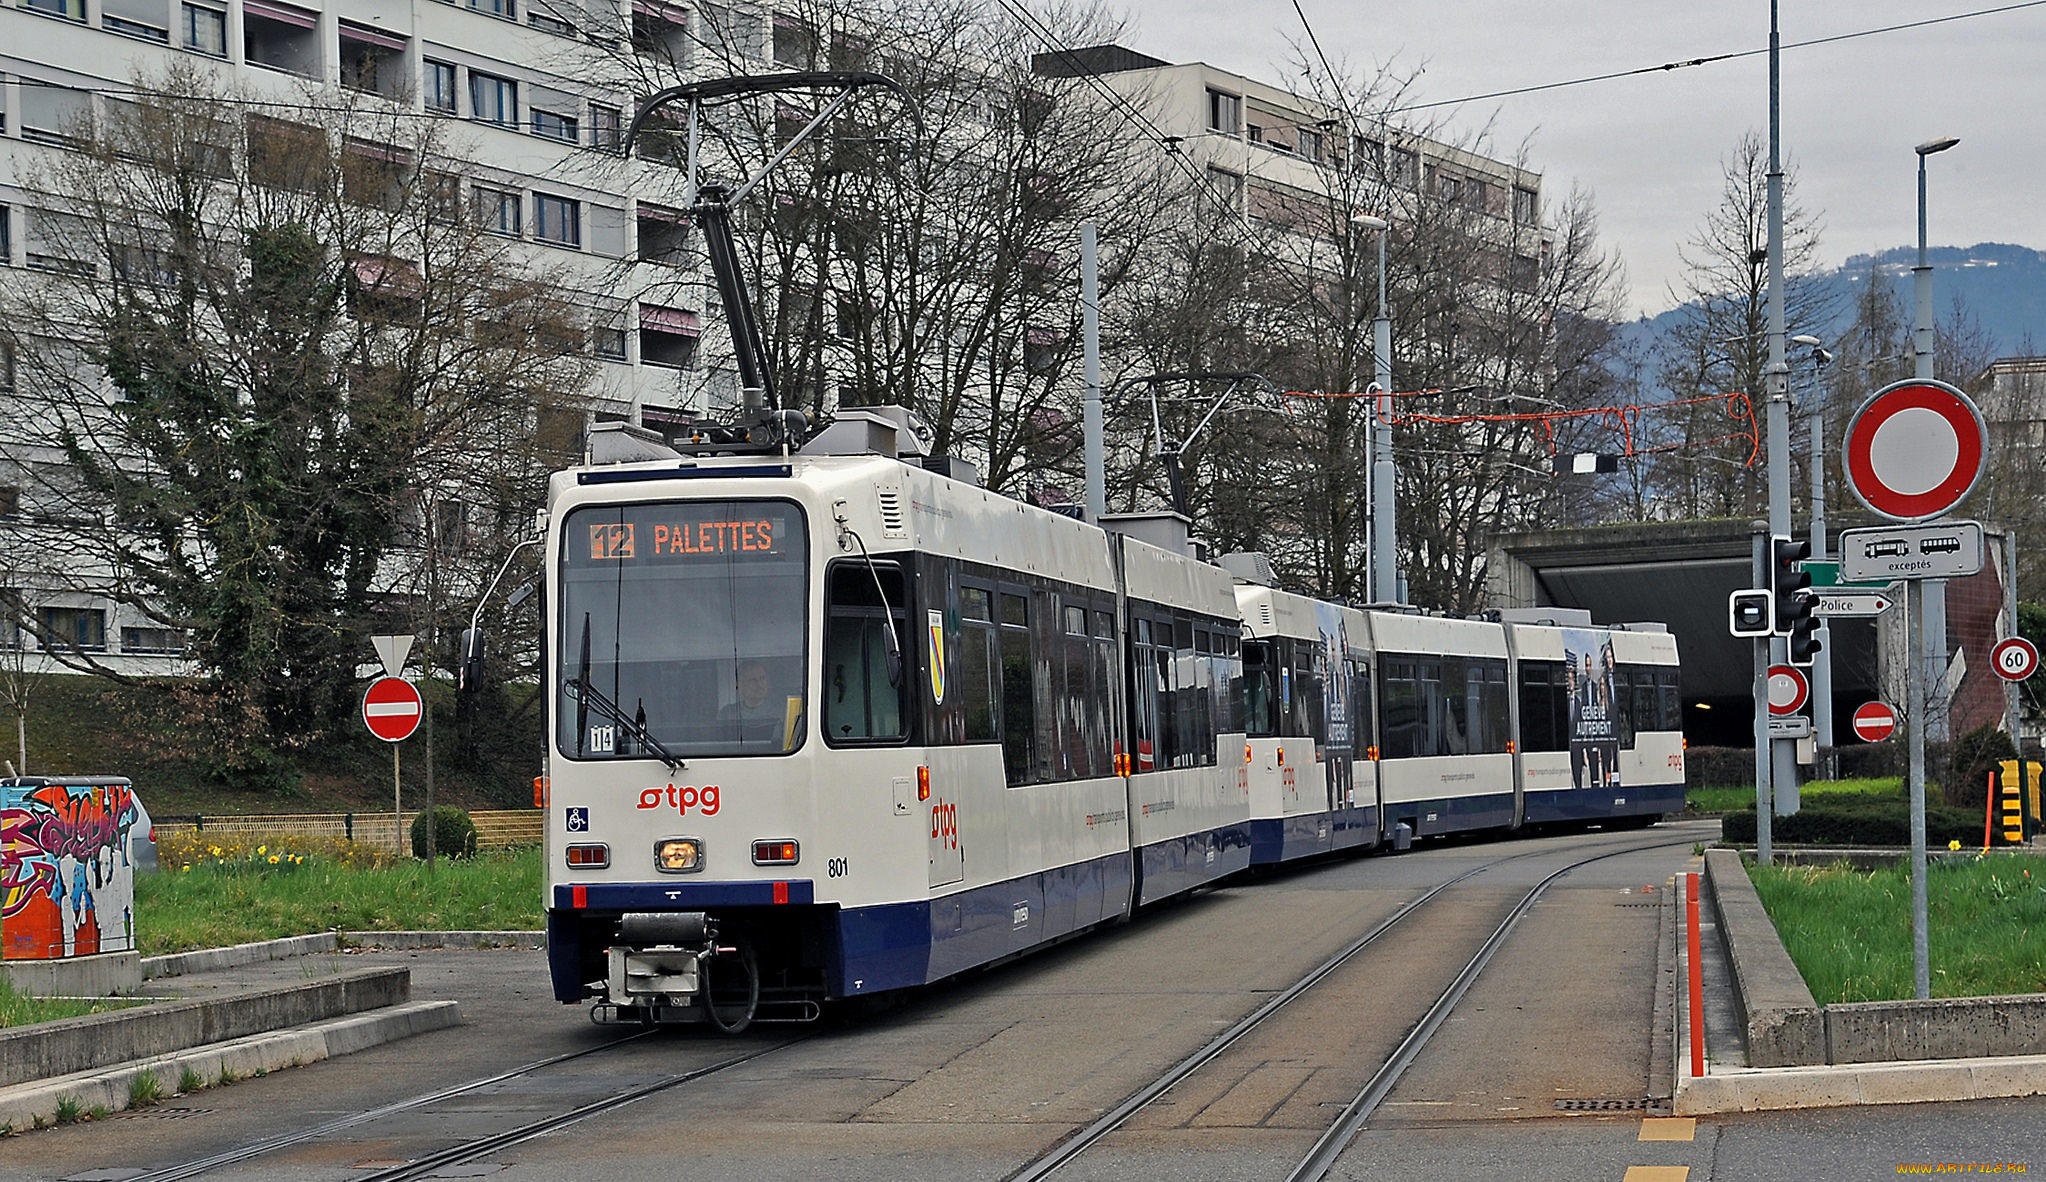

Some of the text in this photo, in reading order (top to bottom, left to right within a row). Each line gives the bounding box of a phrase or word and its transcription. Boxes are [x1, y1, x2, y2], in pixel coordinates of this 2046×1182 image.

[593, 520, 772, 558] 12 PALETTES
[1888, 559, 1932, 572] exceptés
[1820, 600, 1853, 611] Police
[2005, 652, 2024, 668] 60
[592, 730, 612, 749] 14
[828, 857, 848, 878] 801
